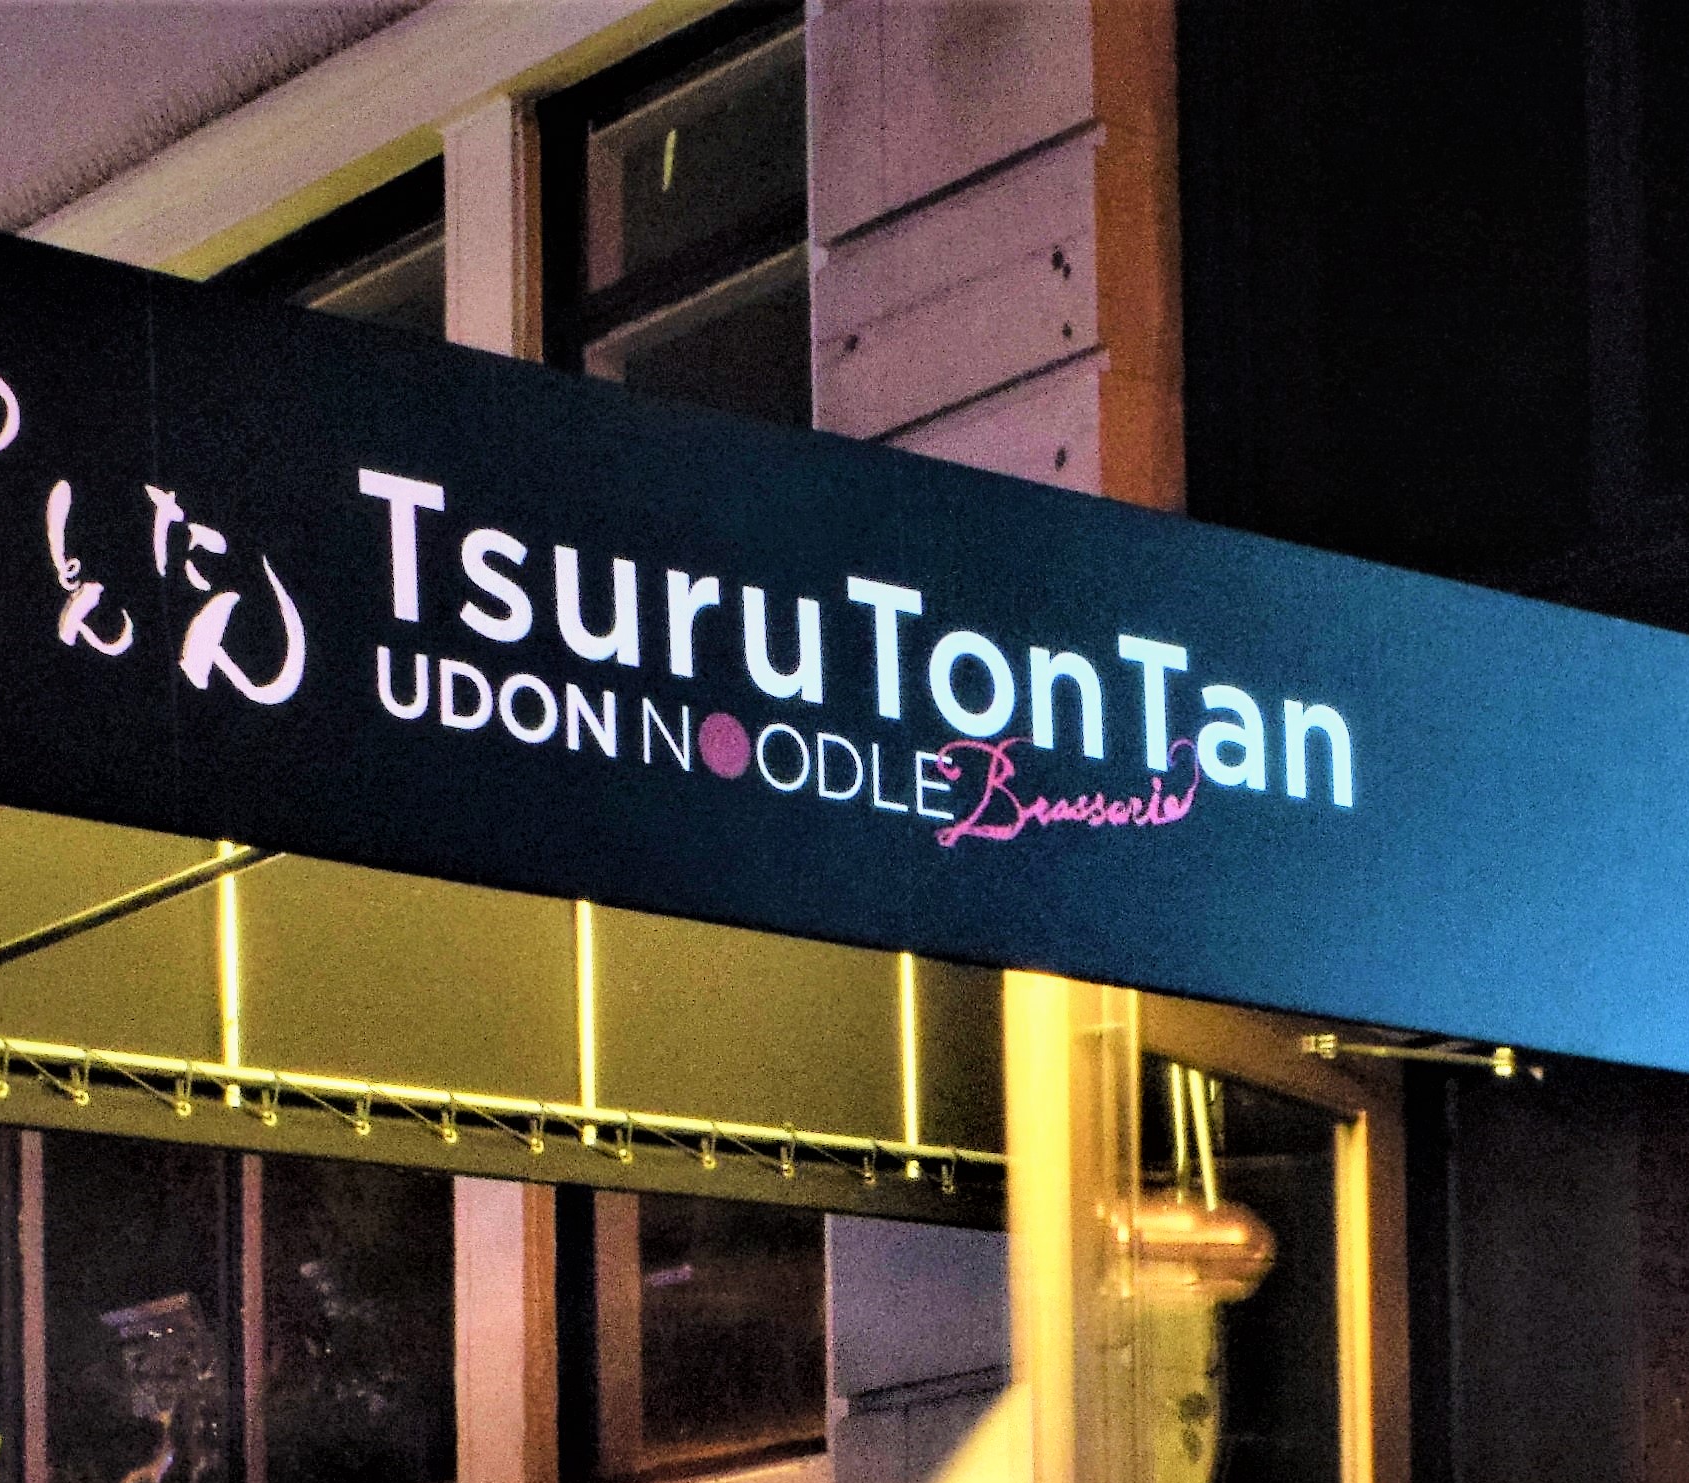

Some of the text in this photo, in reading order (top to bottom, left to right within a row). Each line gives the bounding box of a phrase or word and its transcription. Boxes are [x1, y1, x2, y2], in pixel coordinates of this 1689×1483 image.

[358, 467, 1355, 810] TsuruTonTan
[376, 645, 618, 759] UDON
[935, 736, 1200, 848] Brasserie
